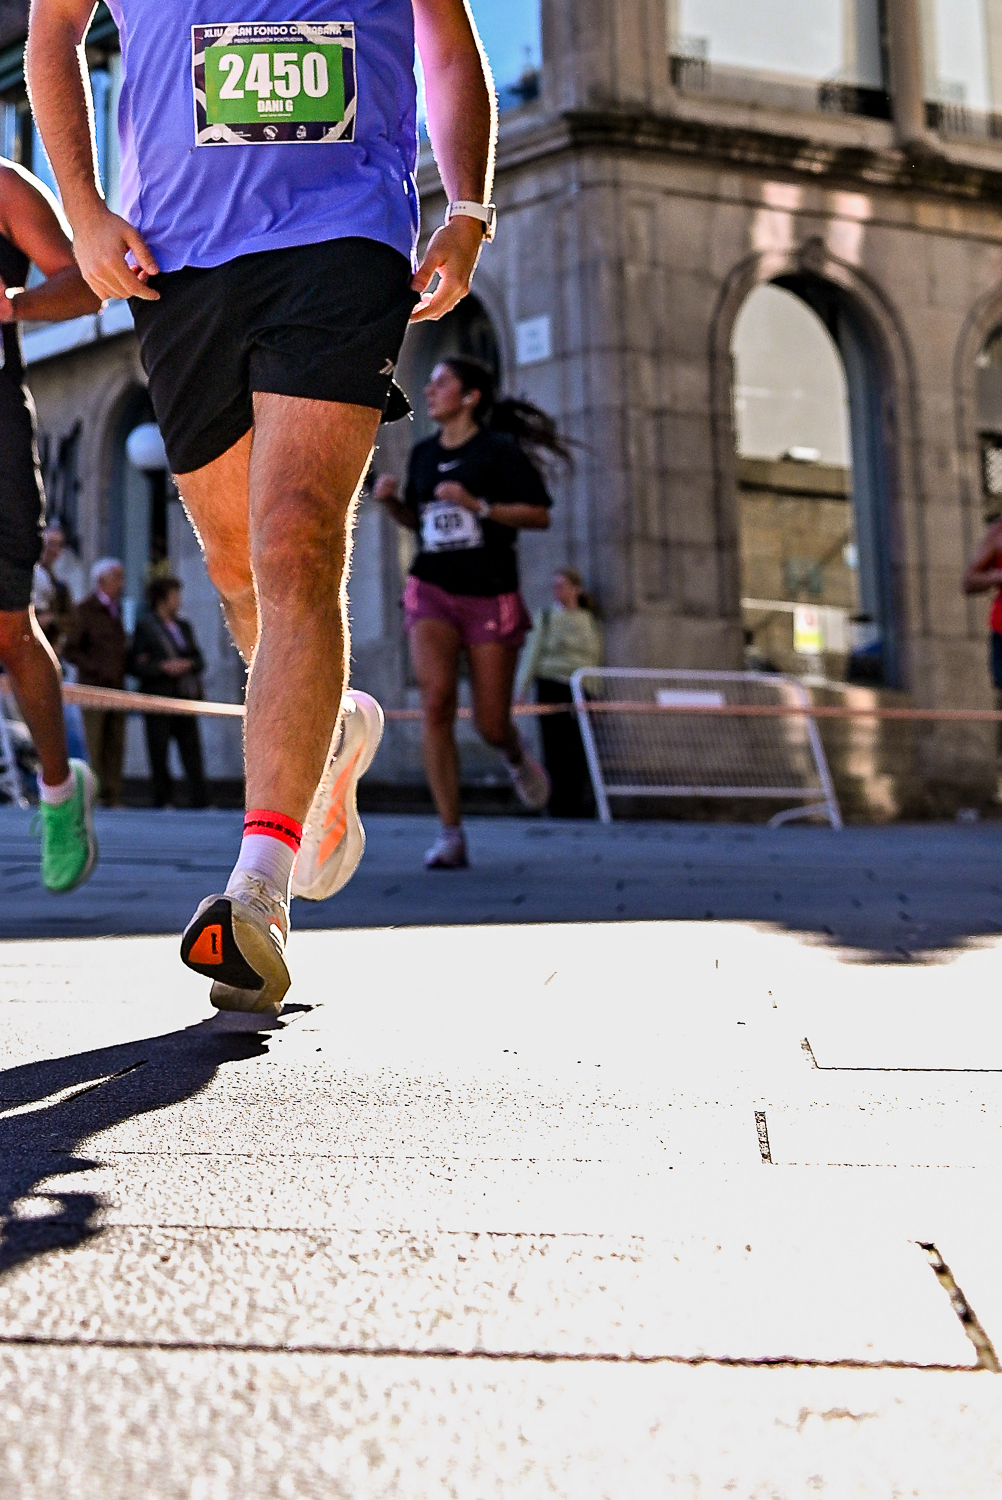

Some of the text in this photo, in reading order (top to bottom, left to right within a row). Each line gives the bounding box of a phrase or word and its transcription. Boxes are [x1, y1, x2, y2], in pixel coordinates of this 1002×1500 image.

[204, 28, 224, 38] XLIV
[253, 26, 288, 36] FONDO
[289, 25, 343, 36] CAABANK
[218, 51, 329, 100] 2450
[257, 99, 294, 113] DANI G
